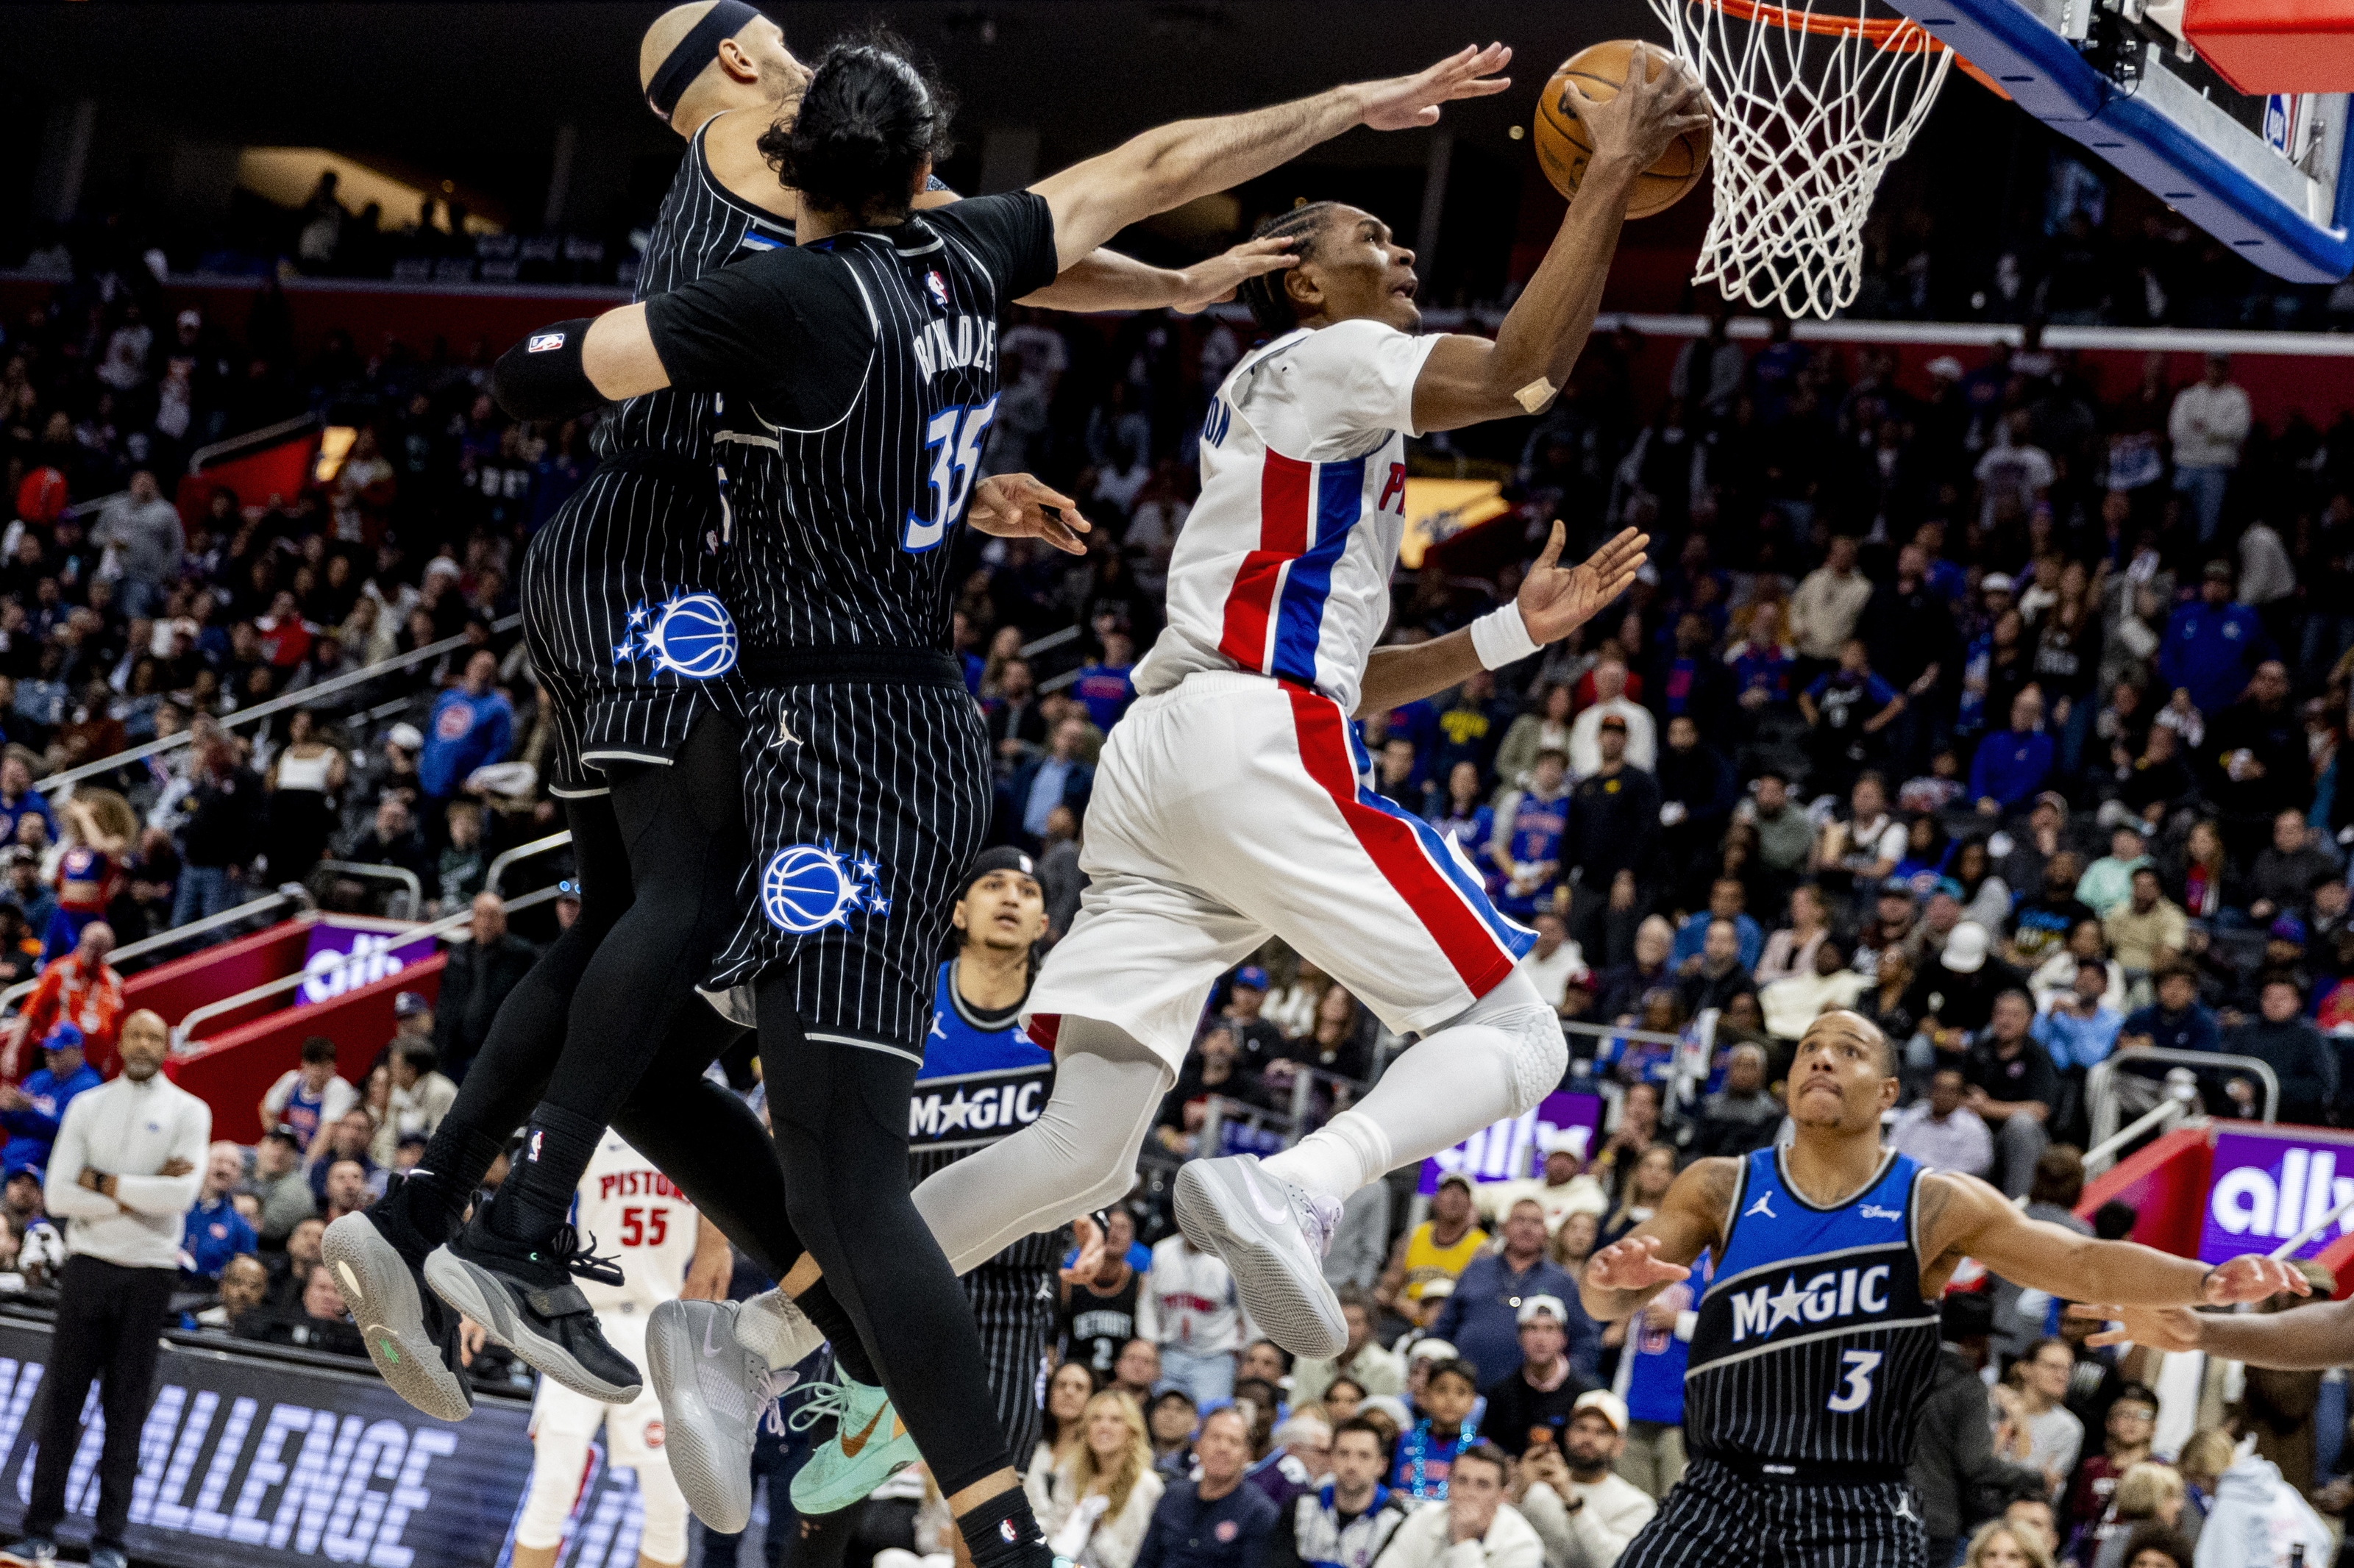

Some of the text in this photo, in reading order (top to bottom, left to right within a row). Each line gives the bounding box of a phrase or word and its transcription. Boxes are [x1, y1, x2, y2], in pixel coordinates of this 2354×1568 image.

[1199, 395, 1231, 449] ON
[903, 391, 1001, 554] 35
[599, 1169, 691, 1206] PISTO
[620, 1206, 670, 1247] 55
[1826, 1348, 1884, 1414] 3
